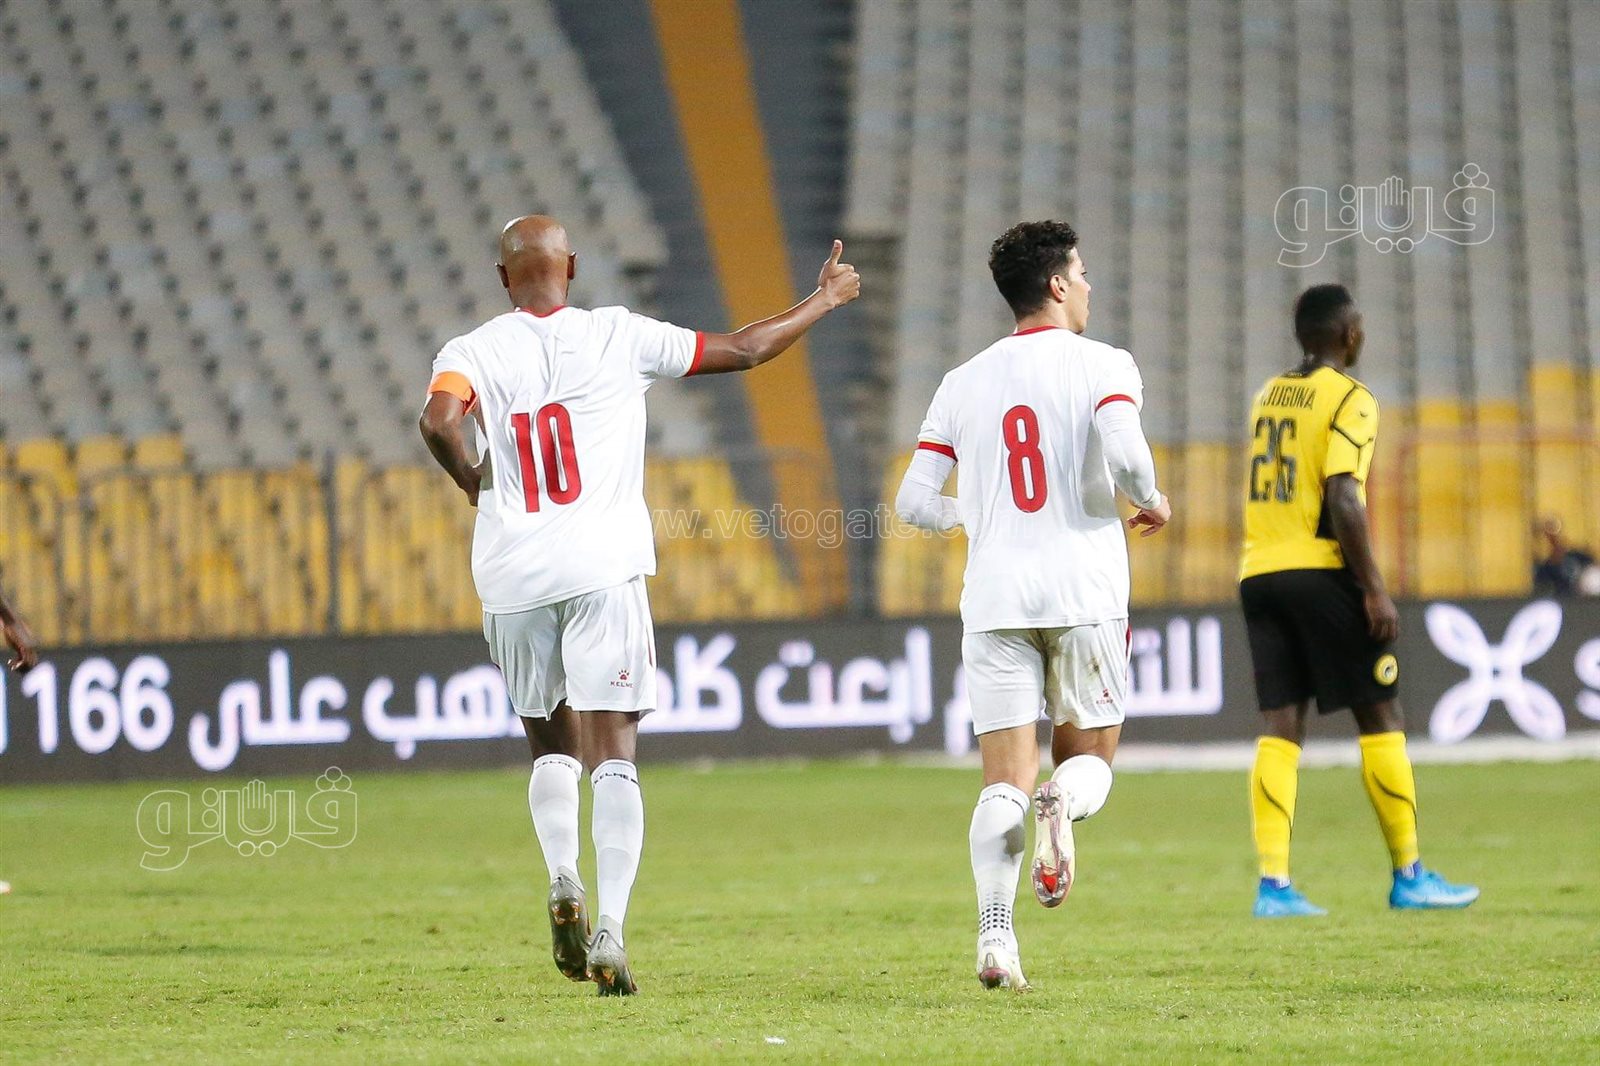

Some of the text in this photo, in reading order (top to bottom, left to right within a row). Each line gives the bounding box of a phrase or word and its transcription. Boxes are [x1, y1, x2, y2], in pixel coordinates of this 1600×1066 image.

[511, 402, 582, 513] 10
[1002, 404, 1048, 513] 8
[1250, 416, 1297, 503] 26
[21, 653, 175, 754] 166
[188, 649, 351, 772] على
